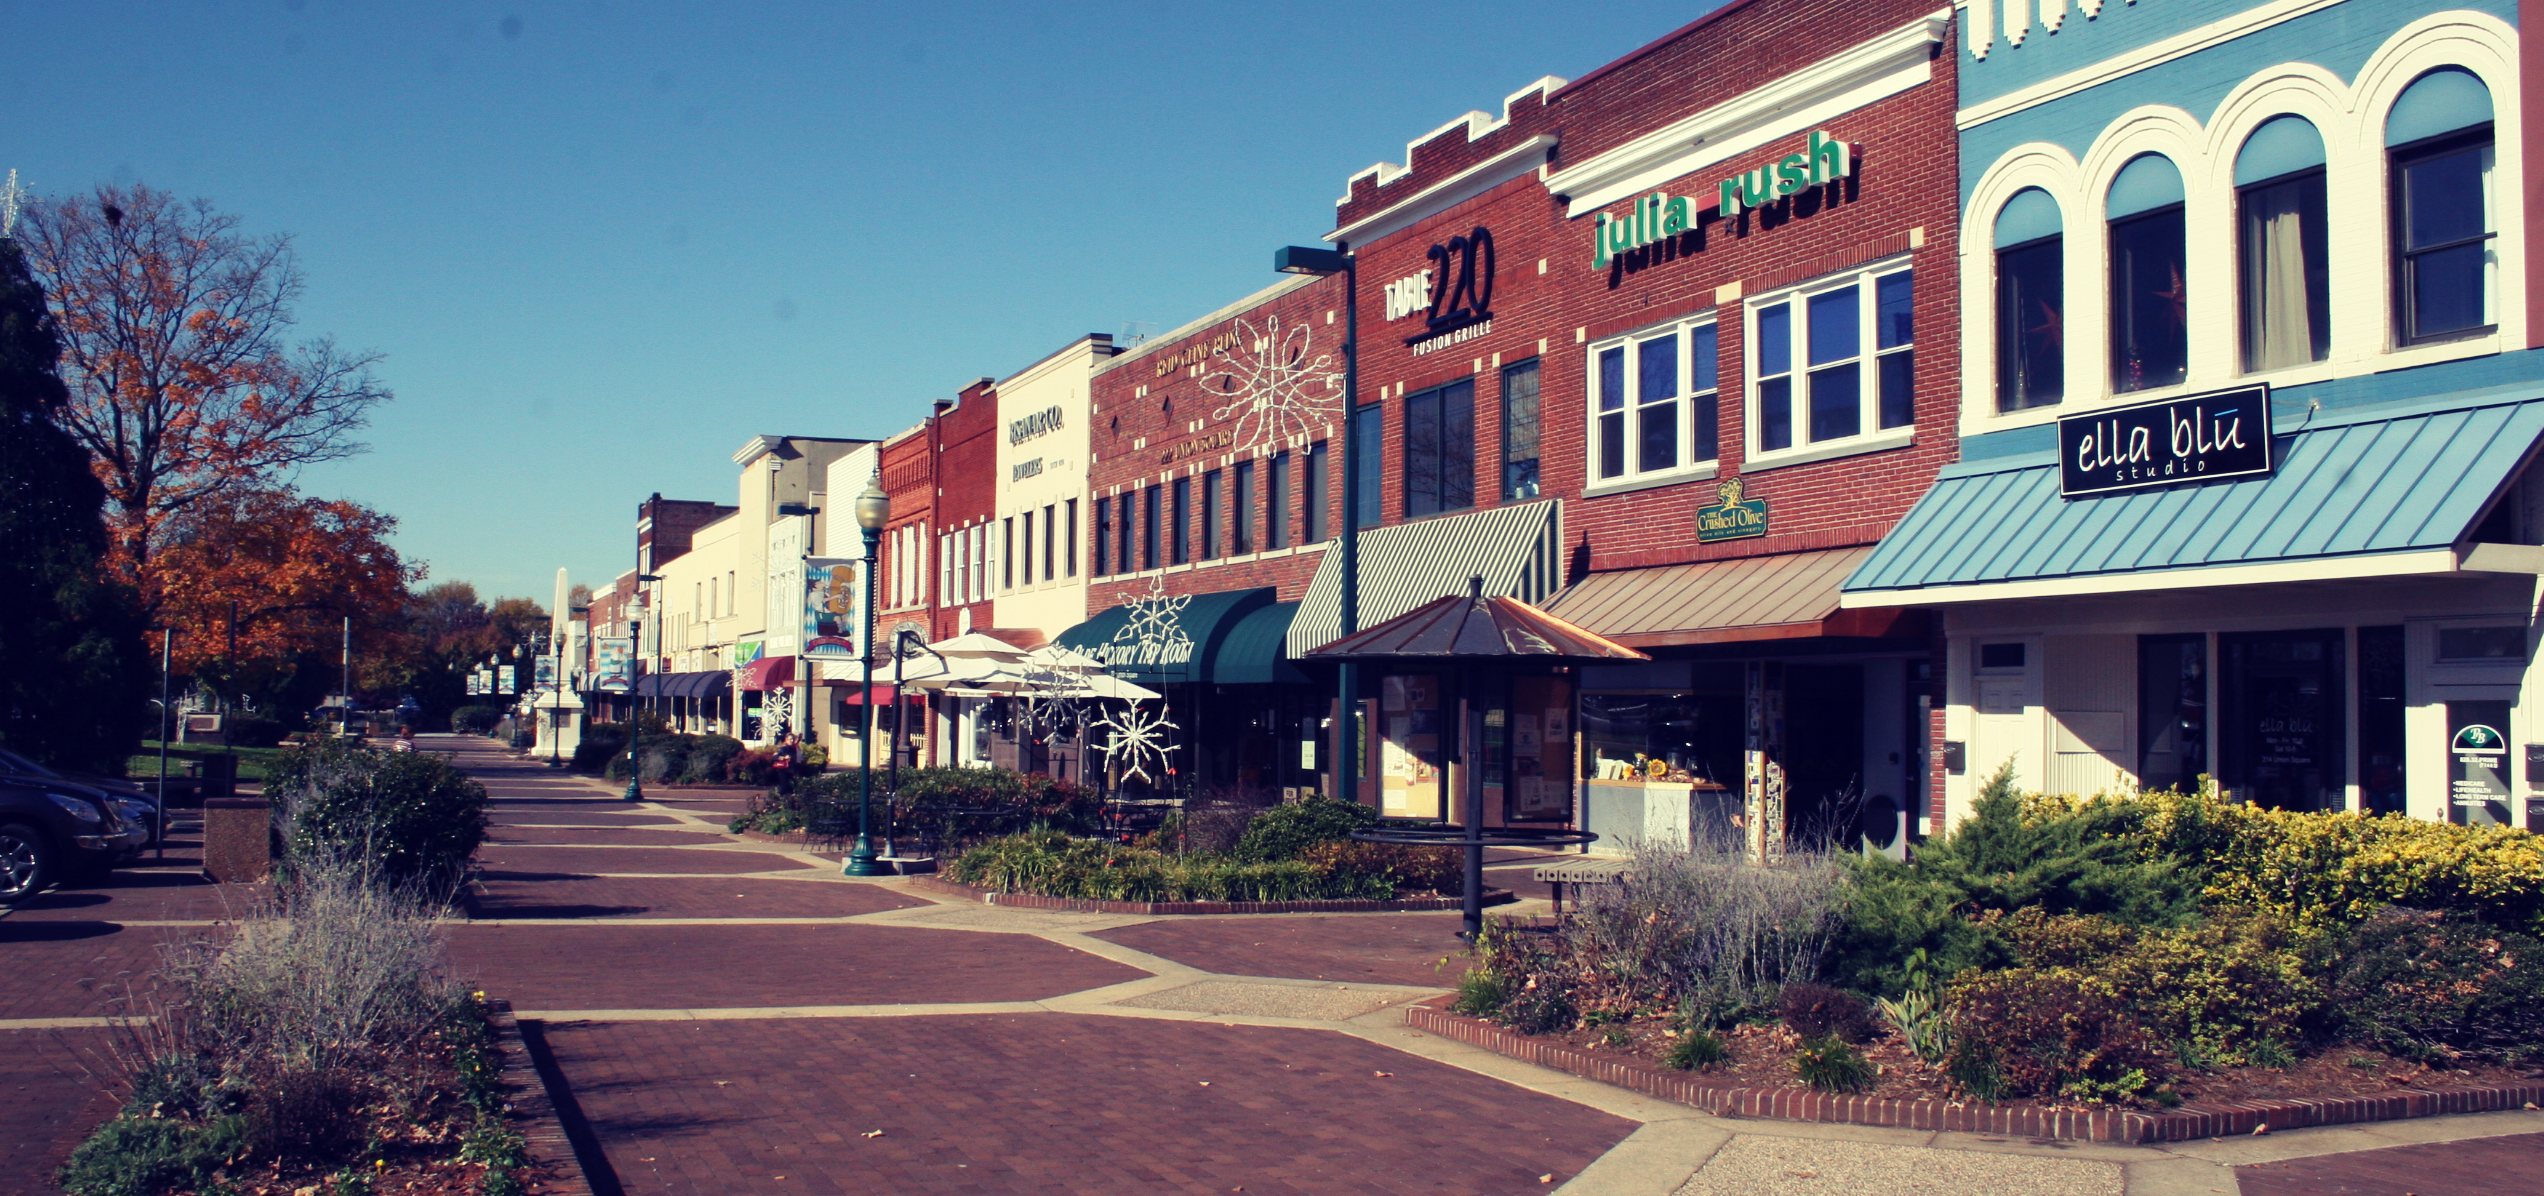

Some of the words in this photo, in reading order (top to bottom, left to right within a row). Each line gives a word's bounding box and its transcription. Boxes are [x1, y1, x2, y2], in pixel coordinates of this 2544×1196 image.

[1592, 192, 1697, 271] julia
[1719, 130, 1850, 216] rush
[1385, 269, 1433, 322] TABLE
[1427, 226, 1495, 327] 220
[1413, 333, 1451, 356] FUSION
[1455, 319, 1492, 343] GRILLE
[1156, 354, 1178, 378] REID
[1181, 341, 1210, 367] CLINE
[1161, 447, 1173, 465] 222
[1176, 438, 1199, 460] UNION
[1202, 430, 1233, 453] SQUARE
[2079, 419, 2152, 472] ella
[1013, 457, 1043, 483] JEWELERS
[2116, 458, 2206, 481] studio
[1698, 510, 1736, 531] Crushed
[1738, 508, 1763, 526] Olive
[1096, 642, 1139, 666] HICKORY
[1138, 639, 1162, 664] TAP
[1160, 638, 1195, 664] ROOM
[2260, 717, 2284, 732] ella
